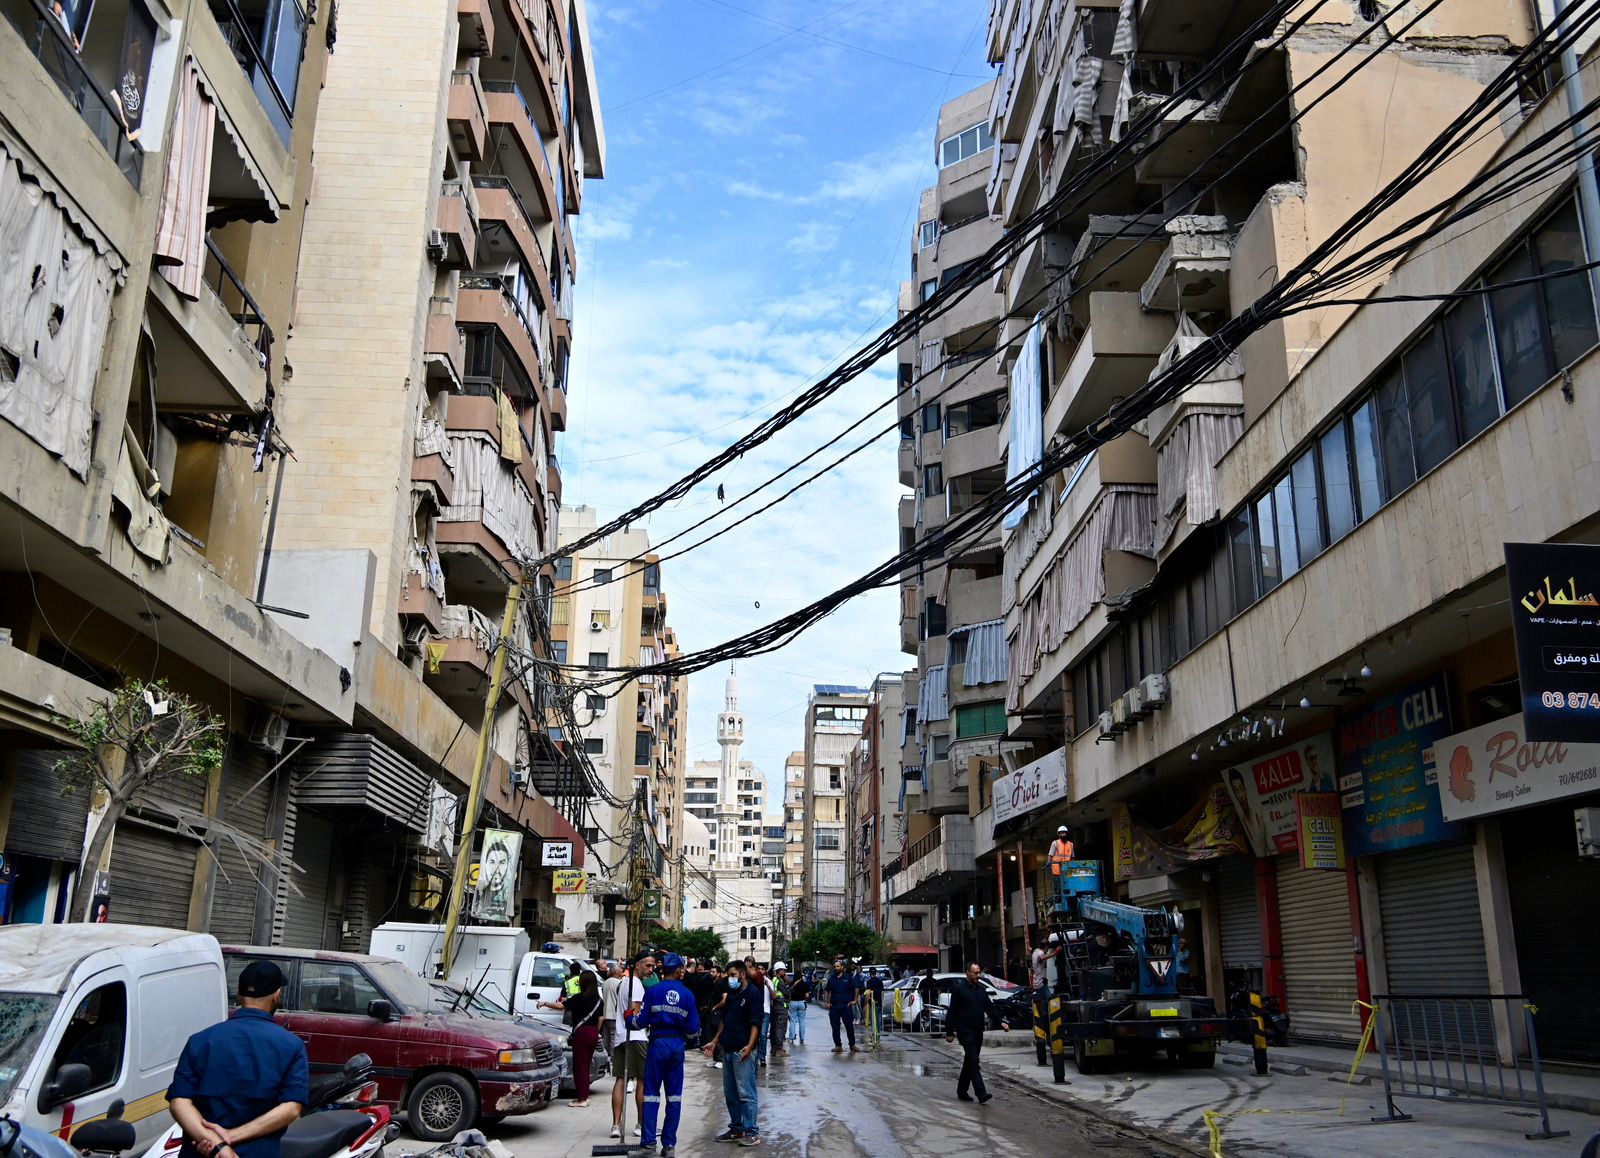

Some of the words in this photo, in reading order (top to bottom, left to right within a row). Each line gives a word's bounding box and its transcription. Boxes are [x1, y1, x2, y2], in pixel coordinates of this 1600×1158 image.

[1520, 576, 1600, 613] سلمان
[1553, 653, 1587, 665] ومفرق
[1401, 684, 1444, 731] CELL
[1542, 691, 1564, 708] 03
[1259, 755, 1300, 791] 4ALL
[1515, 783, 1532, 797] Salon
[1309, 819, 1335, 833] CELL
